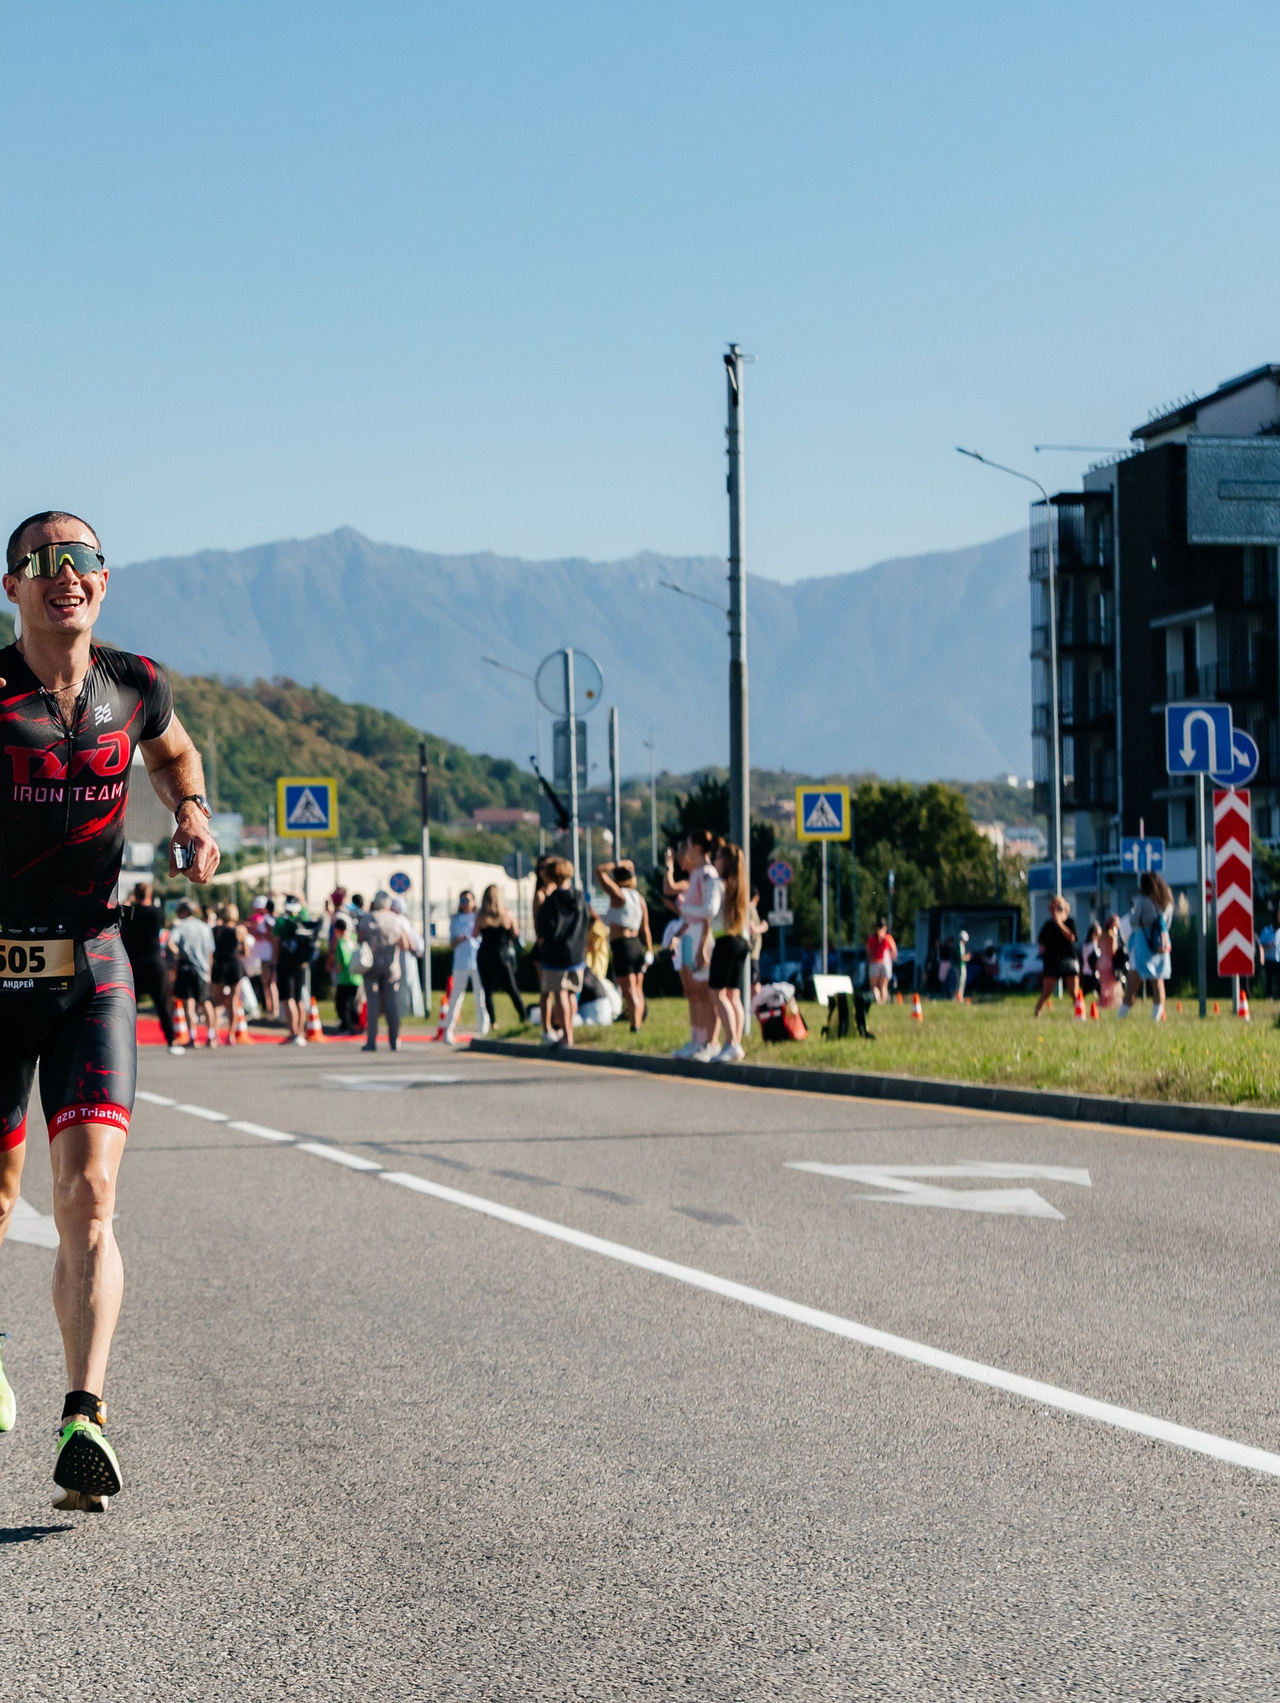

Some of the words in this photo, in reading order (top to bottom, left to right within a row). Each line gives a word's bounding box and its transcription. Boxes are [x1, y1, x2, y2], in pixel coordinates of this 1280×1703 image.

[13, 785, 64, 803] IRON
[73, 780, 124, 802] TEAM
[2, 978, 34, 990] АНДРЕЙ
[56, 1110, 76, 1126] RZD
